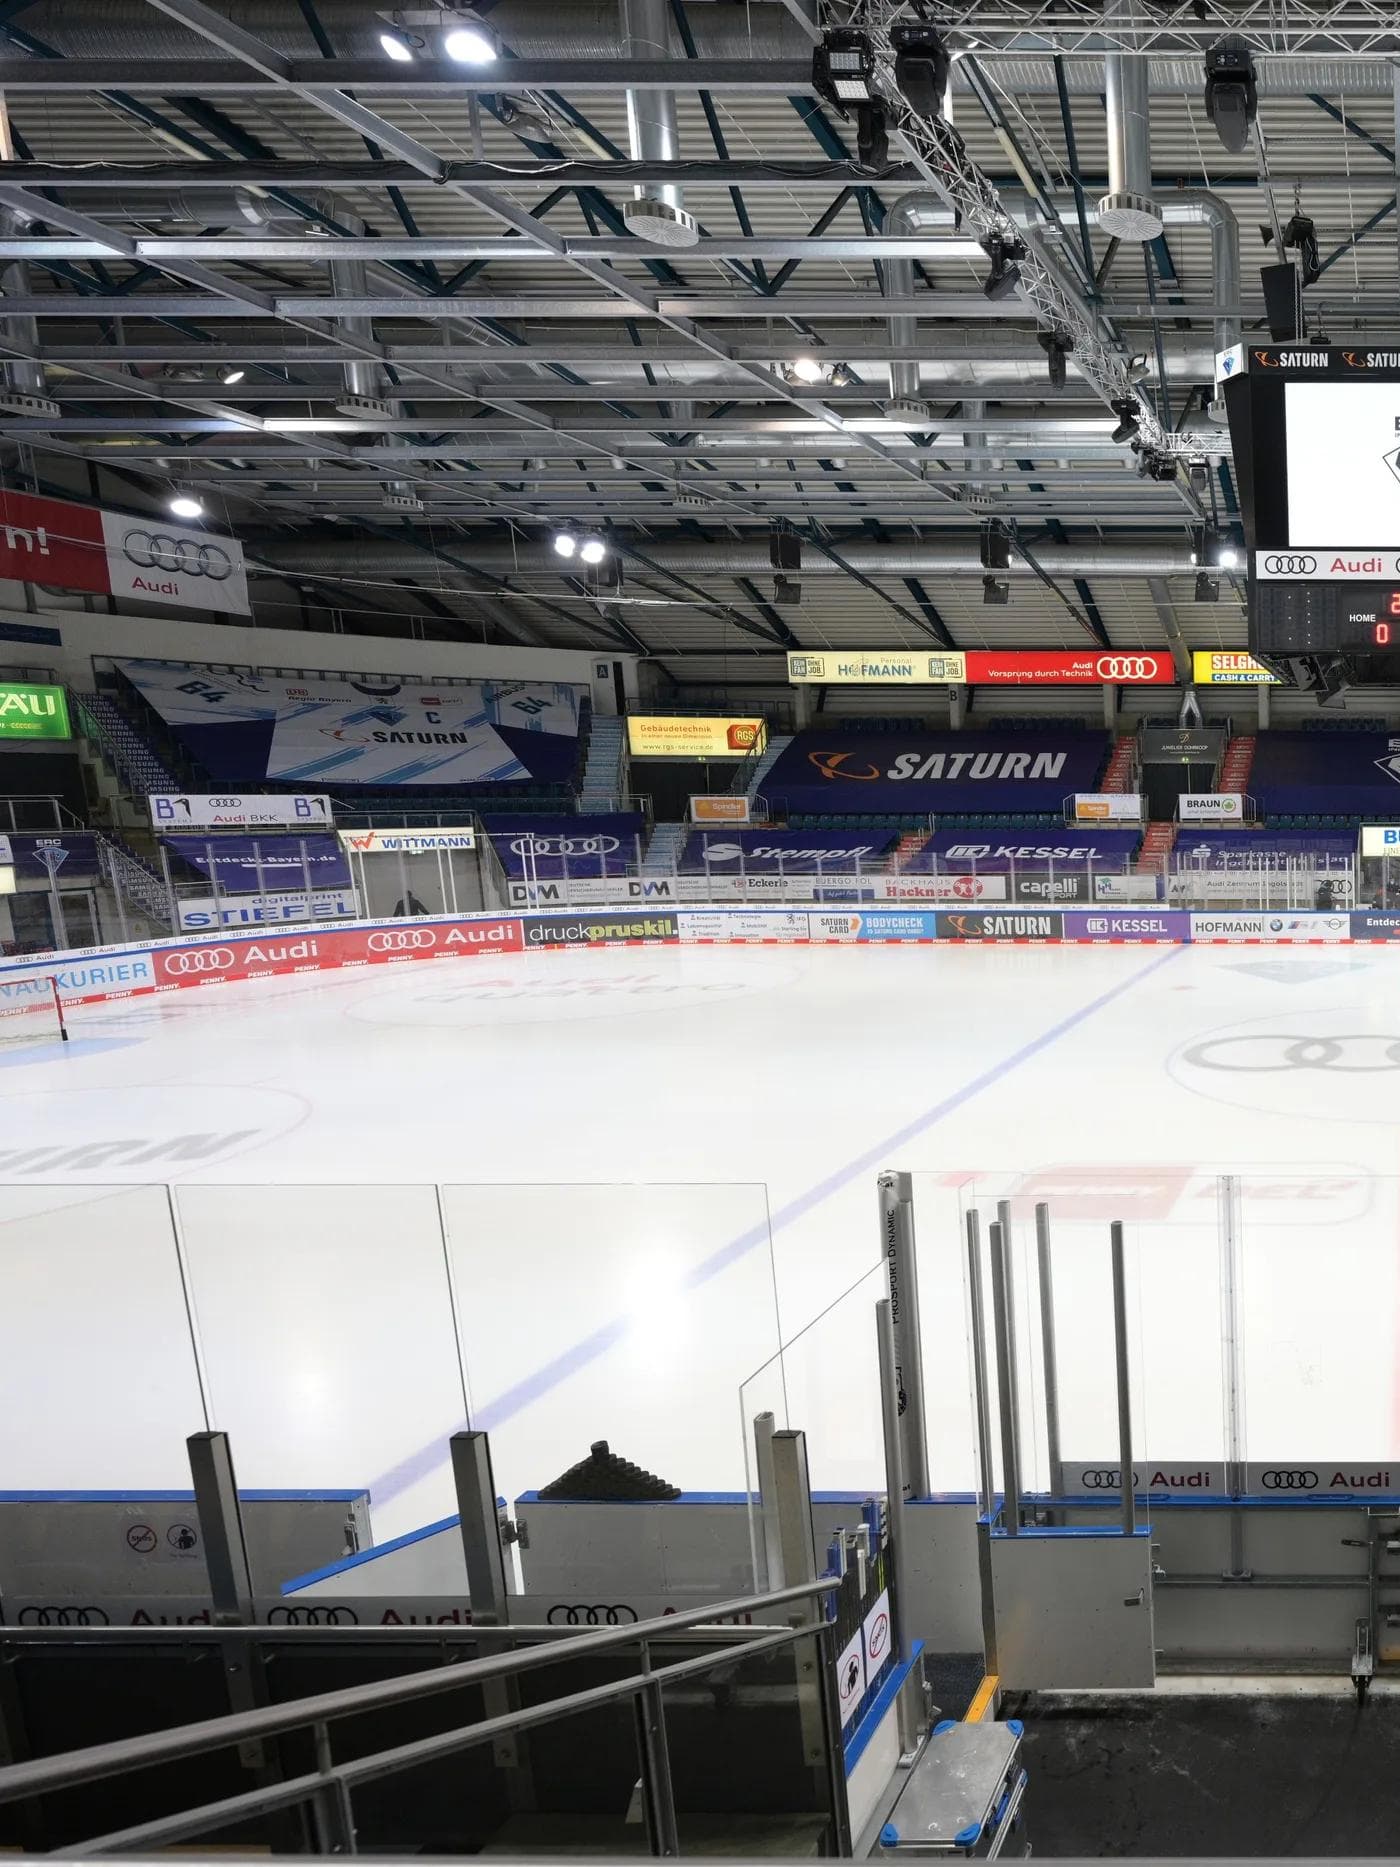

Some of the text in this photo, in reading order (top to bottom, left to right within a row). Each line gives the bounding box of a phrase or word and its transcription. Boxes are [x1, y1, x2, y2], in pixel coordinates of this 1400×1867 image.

[1280, 352, 1328, 368] SATURN
[1330, 558, 1382, 573] Audi
[132, 576, 179, 595] Audi
[1349, 614, 1376, 623] HOME
[1376, 624, 1388, 643] 0
[988, 670, 1033, 679] Vorsprung
[950, 691, 957, 701] B
[425, 711, 441, 724] C
[373, 731, 468, 745] SATURN
[736, 730, 754, 740] RGS
[887, 752, 1067, 779] SATURN
[1187, 800, 1221, 808] BRAUN
[213, 814, 278, 823] Audi BKK
[382, 837, 471, 849] WITTMANN
[993, 846, 1102, 858] KESSEL
[748, 879, 788, 888] Eckerle
[1020, 878, 1078, 898] capelli
[886, 886, 951, 897] Hackner
[252, 892, 343, 905] digitalprint
[183, 902, 355, 926] STIEFEL
[820, 917, 849, 926] SATURN
[866, 917, 923, 928] BODYCHECK
[983, 916, 1050, 935] SATURN
[1112, 920, 1167, 933] KESSEL
[1195, 922, 1262, 933] HOFMANN
[444, 926, 513, 944] Audi
[530, 920, 678, 941] druckpruskil.
[829, 926, 849, 934] CARD
[244, 941, 319, 965] Audi
[887, 1209, 895, 1258] DYNAMIC
[1150, 1471, 1210, 1488] Audi
[1329, 1471, 1390, 1488] Audi
